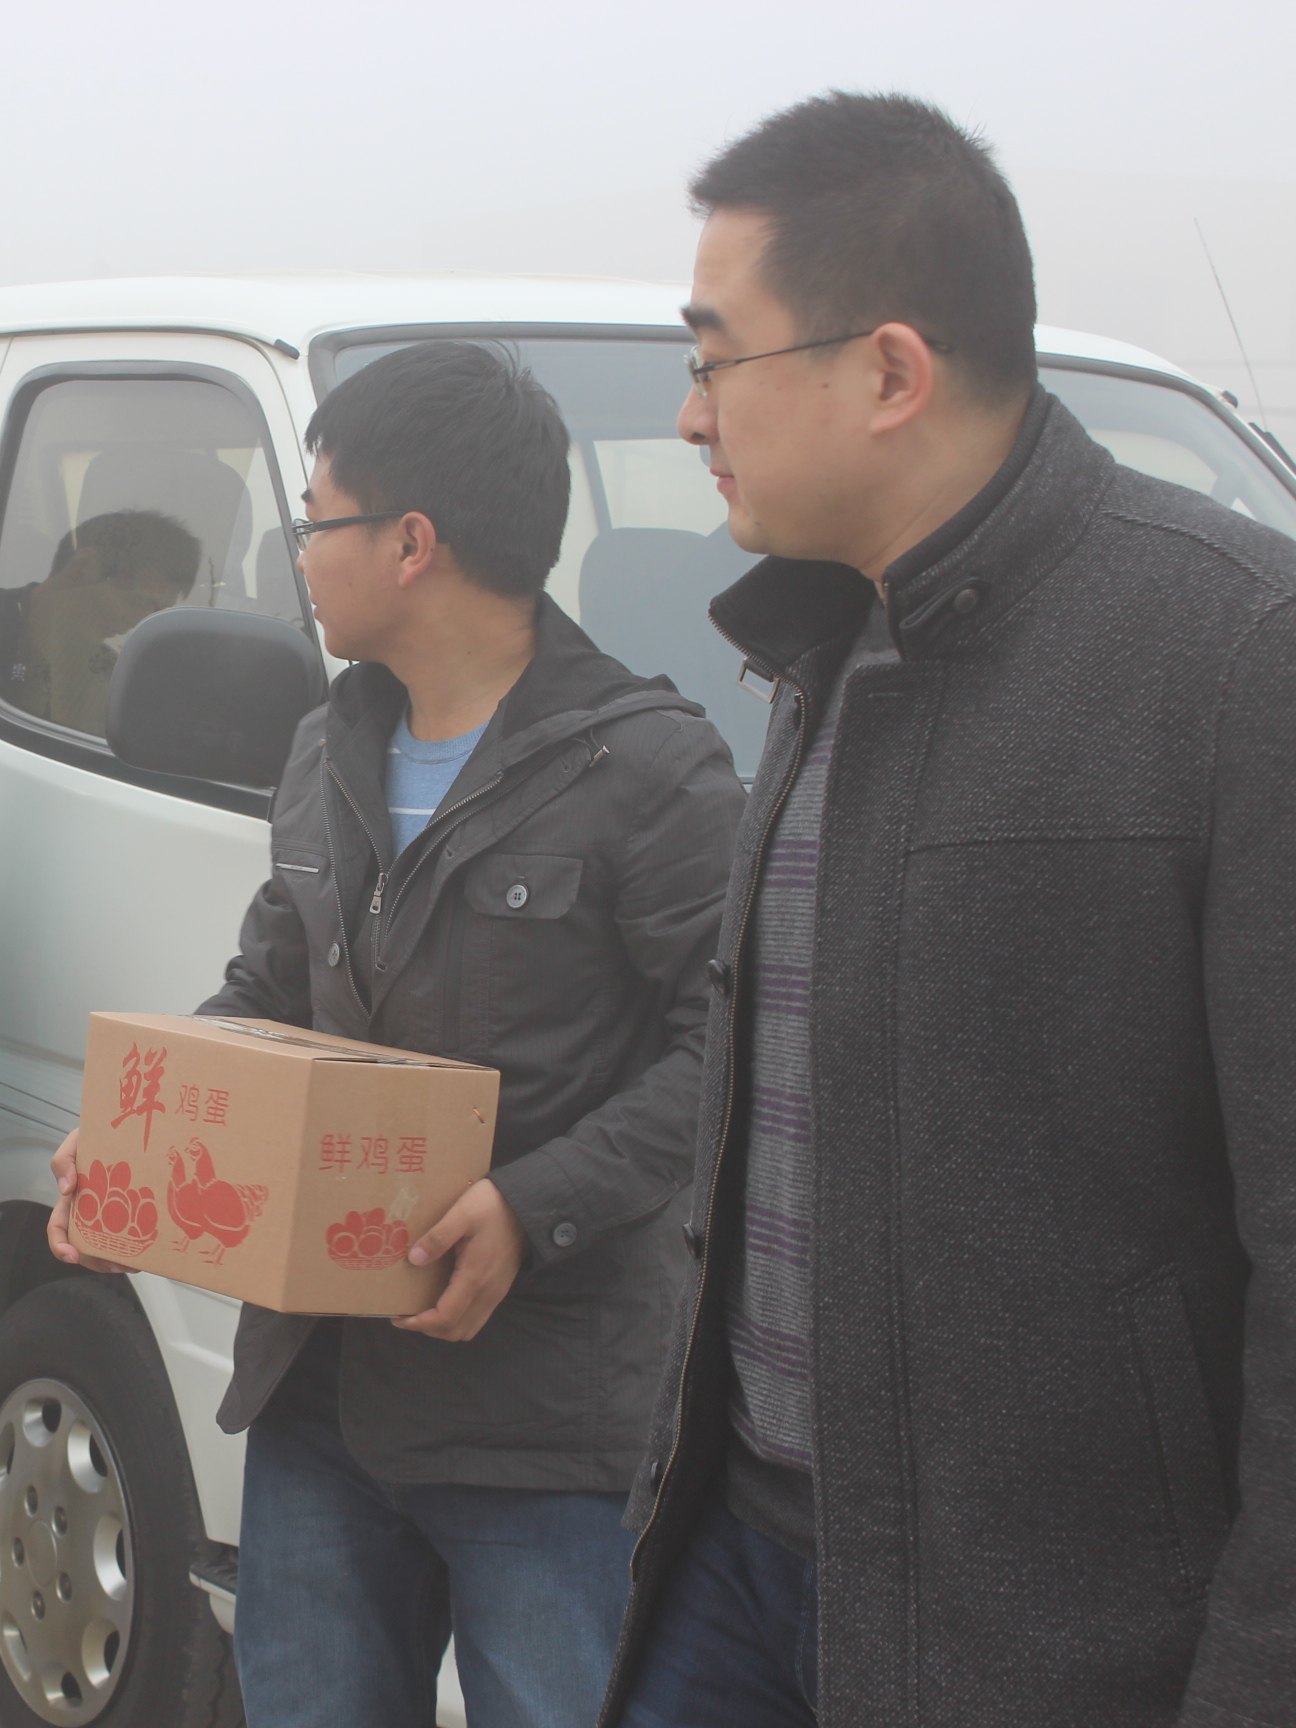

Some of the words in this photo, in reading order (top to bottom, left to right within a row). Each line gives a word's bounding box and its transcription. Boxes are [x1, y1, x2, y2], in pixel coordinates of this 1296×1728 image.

[111, 1043, 230, 1153] 鲜鸡蛋
[318, 1133, 428, 1175] 鲜鸡蛋
